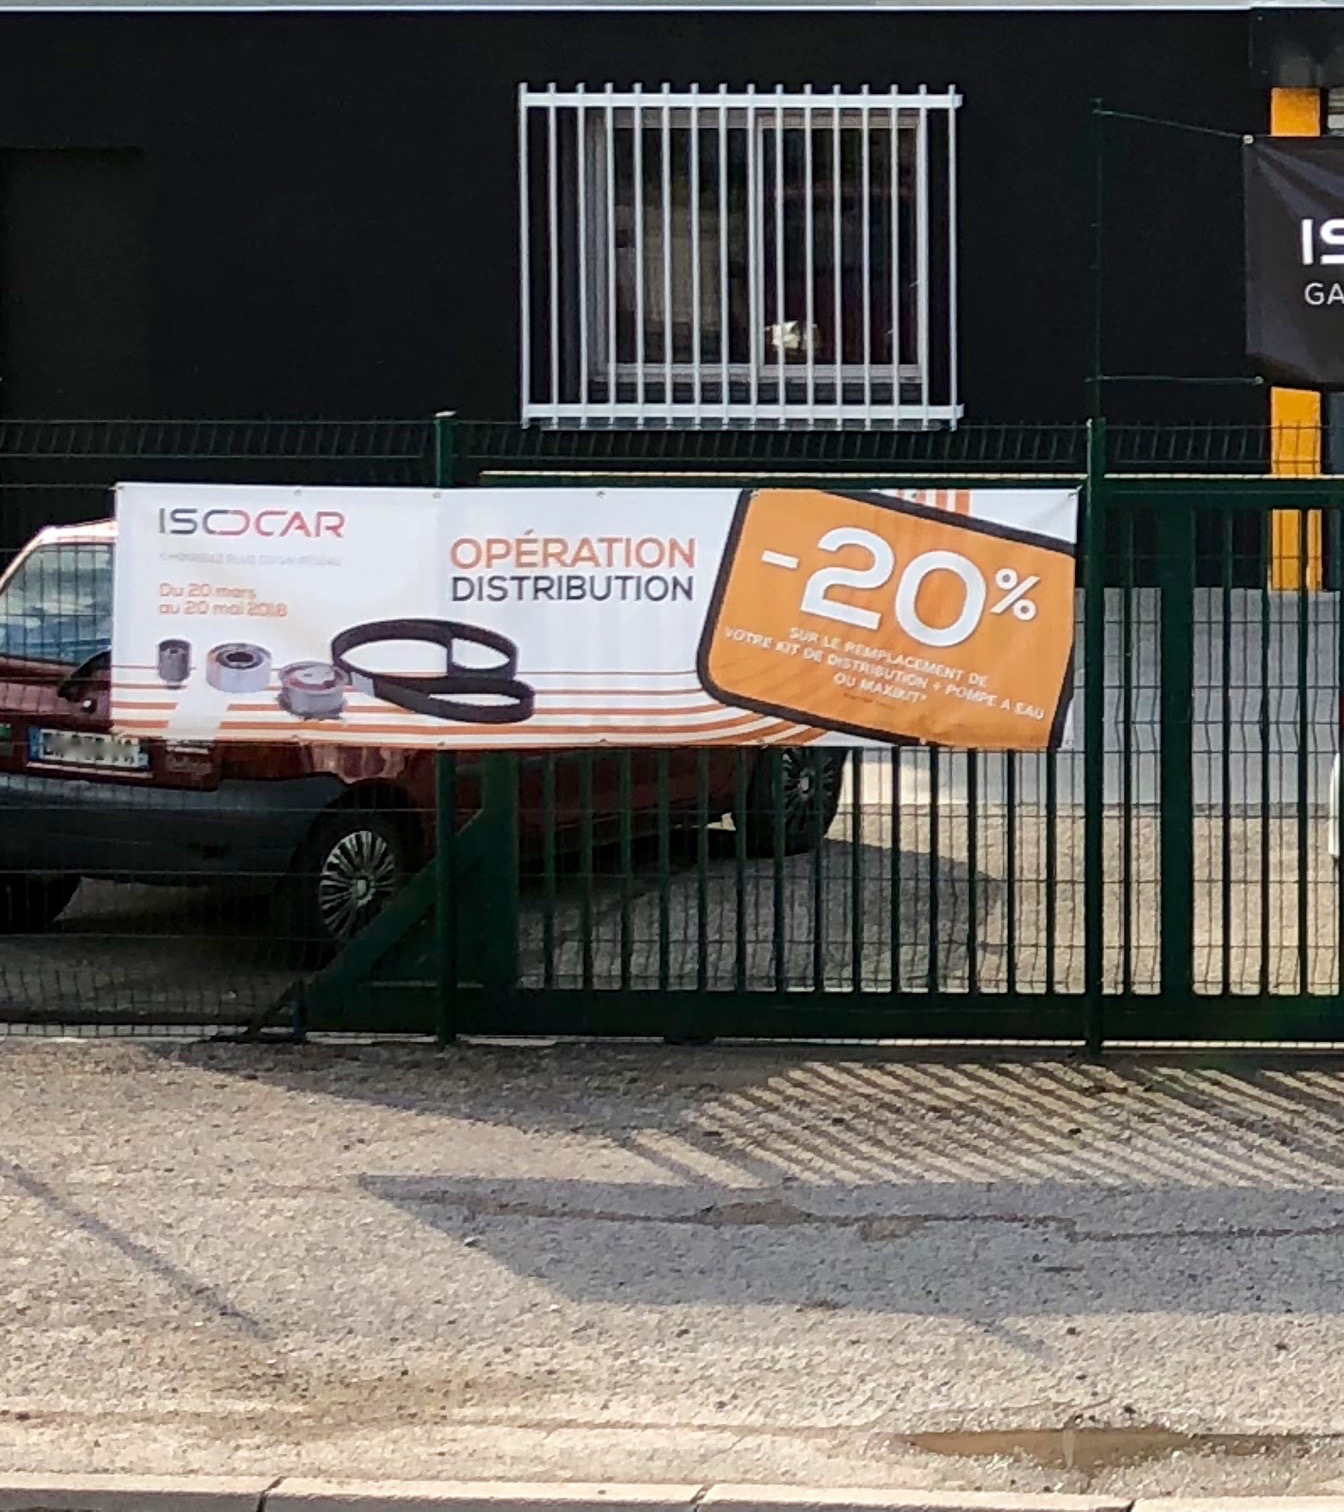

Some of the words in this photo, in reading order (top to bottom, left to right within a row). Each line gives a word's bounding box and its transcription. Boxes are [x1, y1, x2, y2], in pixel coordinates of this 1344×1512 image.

[158, 508, 345, 538] ISOCAR
[450, 529, 695, 569] OPÉRATION
[159, 582, 183, 597] Du
[188, 582, 211, 597] 20
[451, 575, 694, 602] DISTRIBUTION
[761, 526, 1041, 648] -20%
[159, 602, 180, 615] au
[184, 600, 209, 615] 20
[213, 600, 244, 616] mai
[725, 627, 773, 649] VOTRE
[776, 640, 800, 656] KIT
[804, 648, 824, 663] DE
[827, 653, 929, 688] DISTRIBUTION
[945, 685, 999, 707] POMPE
[790, 627, 820, 644] SUR
[823, 636, 842, 649] LE
[845, 640, 963, 679] REMPLACEMENT
[968, 673, 989, 687] DE
[834, 672, 856, 687] OU
